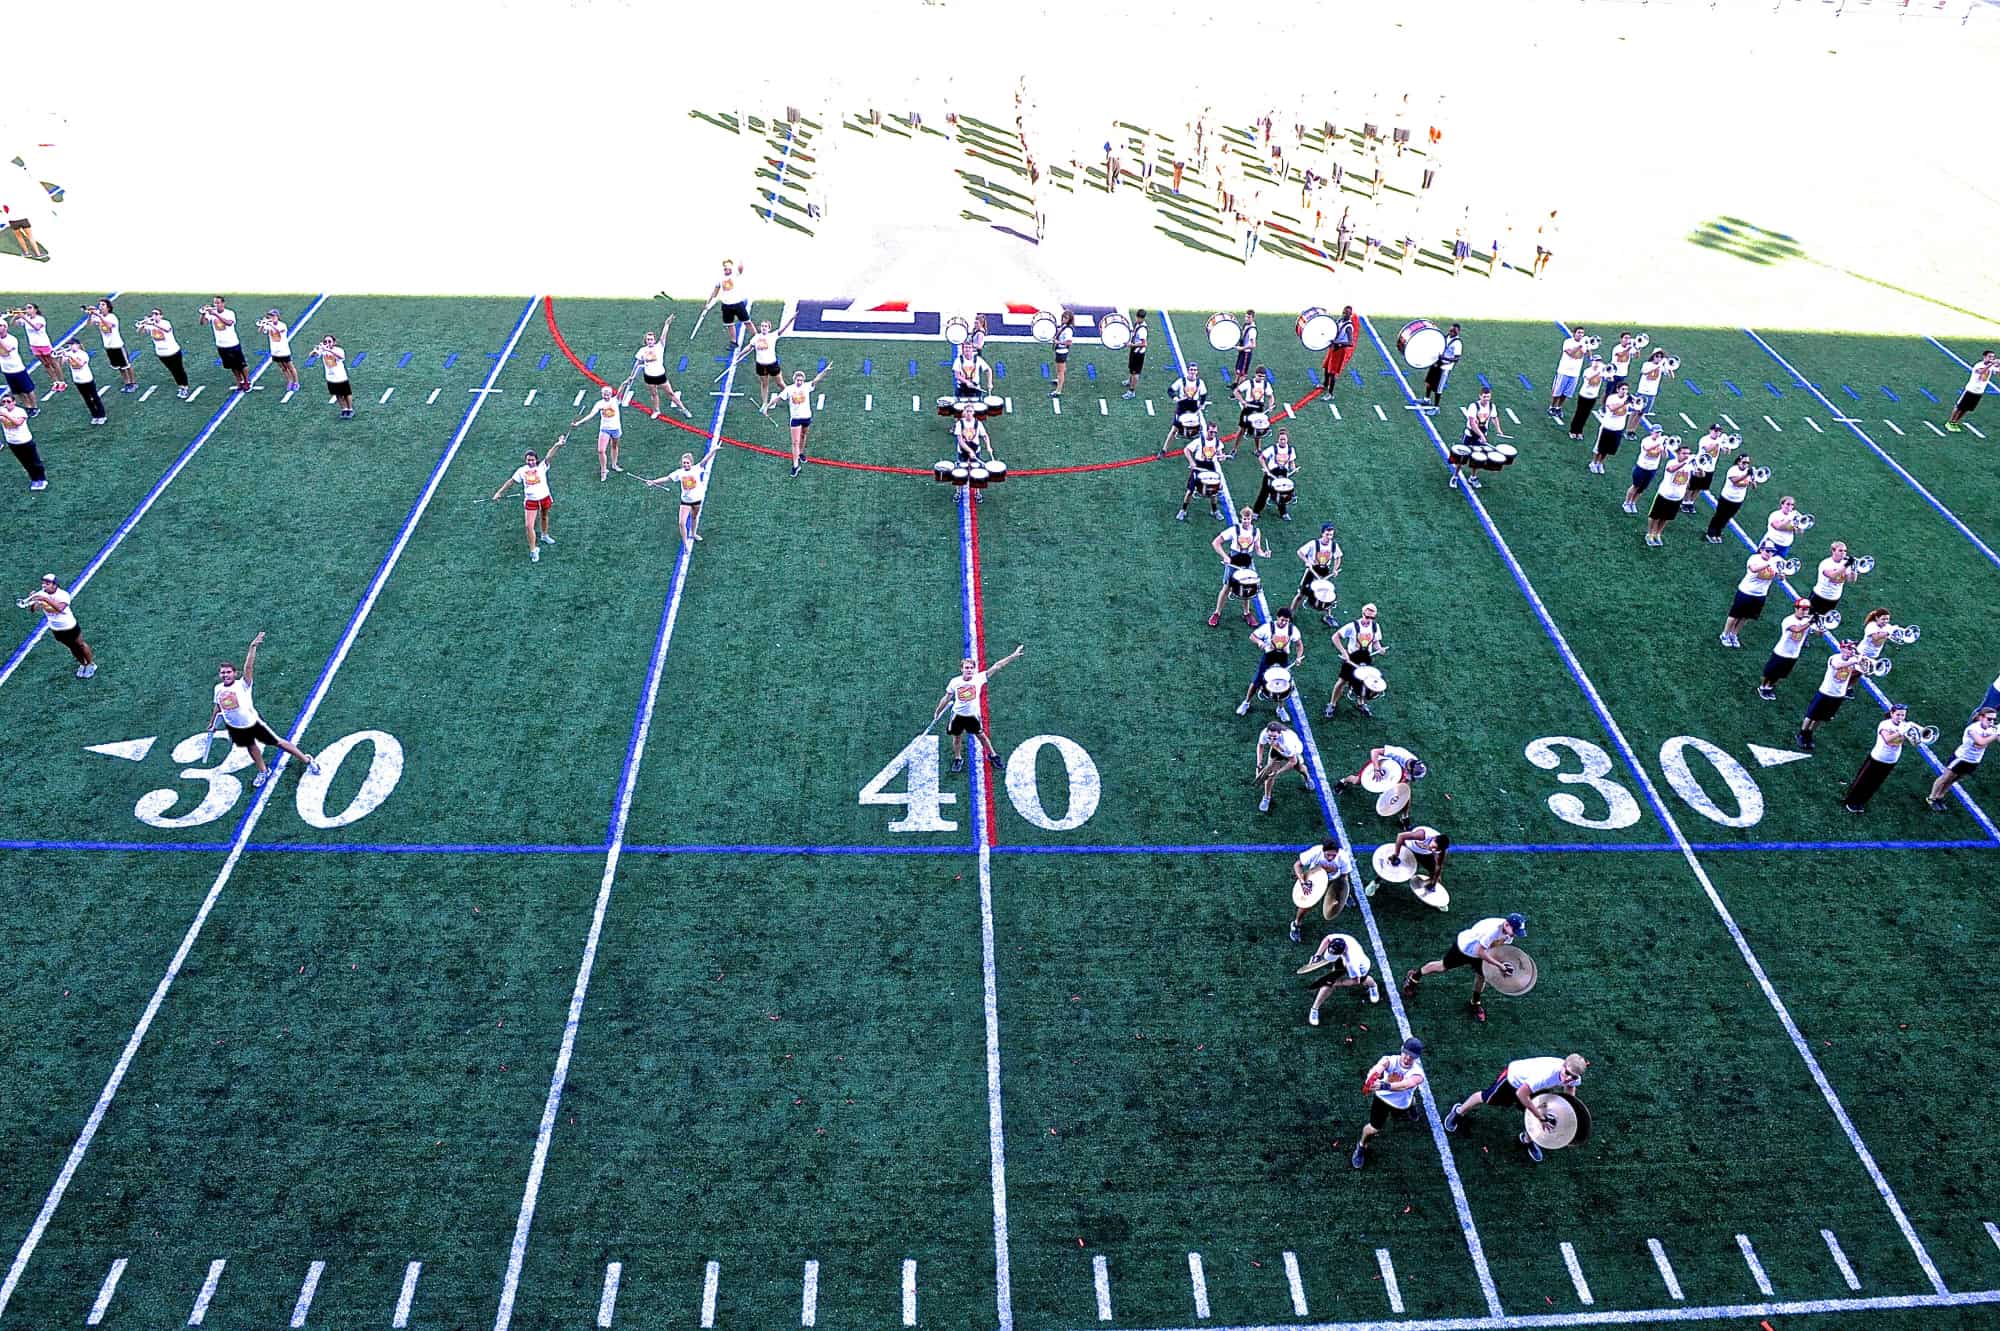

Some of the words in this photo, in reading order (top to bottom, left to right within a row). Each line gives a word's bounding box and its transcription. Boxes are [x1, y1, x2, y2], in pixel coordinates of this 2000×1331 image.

[135, 730, 404, 829] 30
[858, 734, 1102, 832] 40
[1525, 735, 1764, 830] 30
